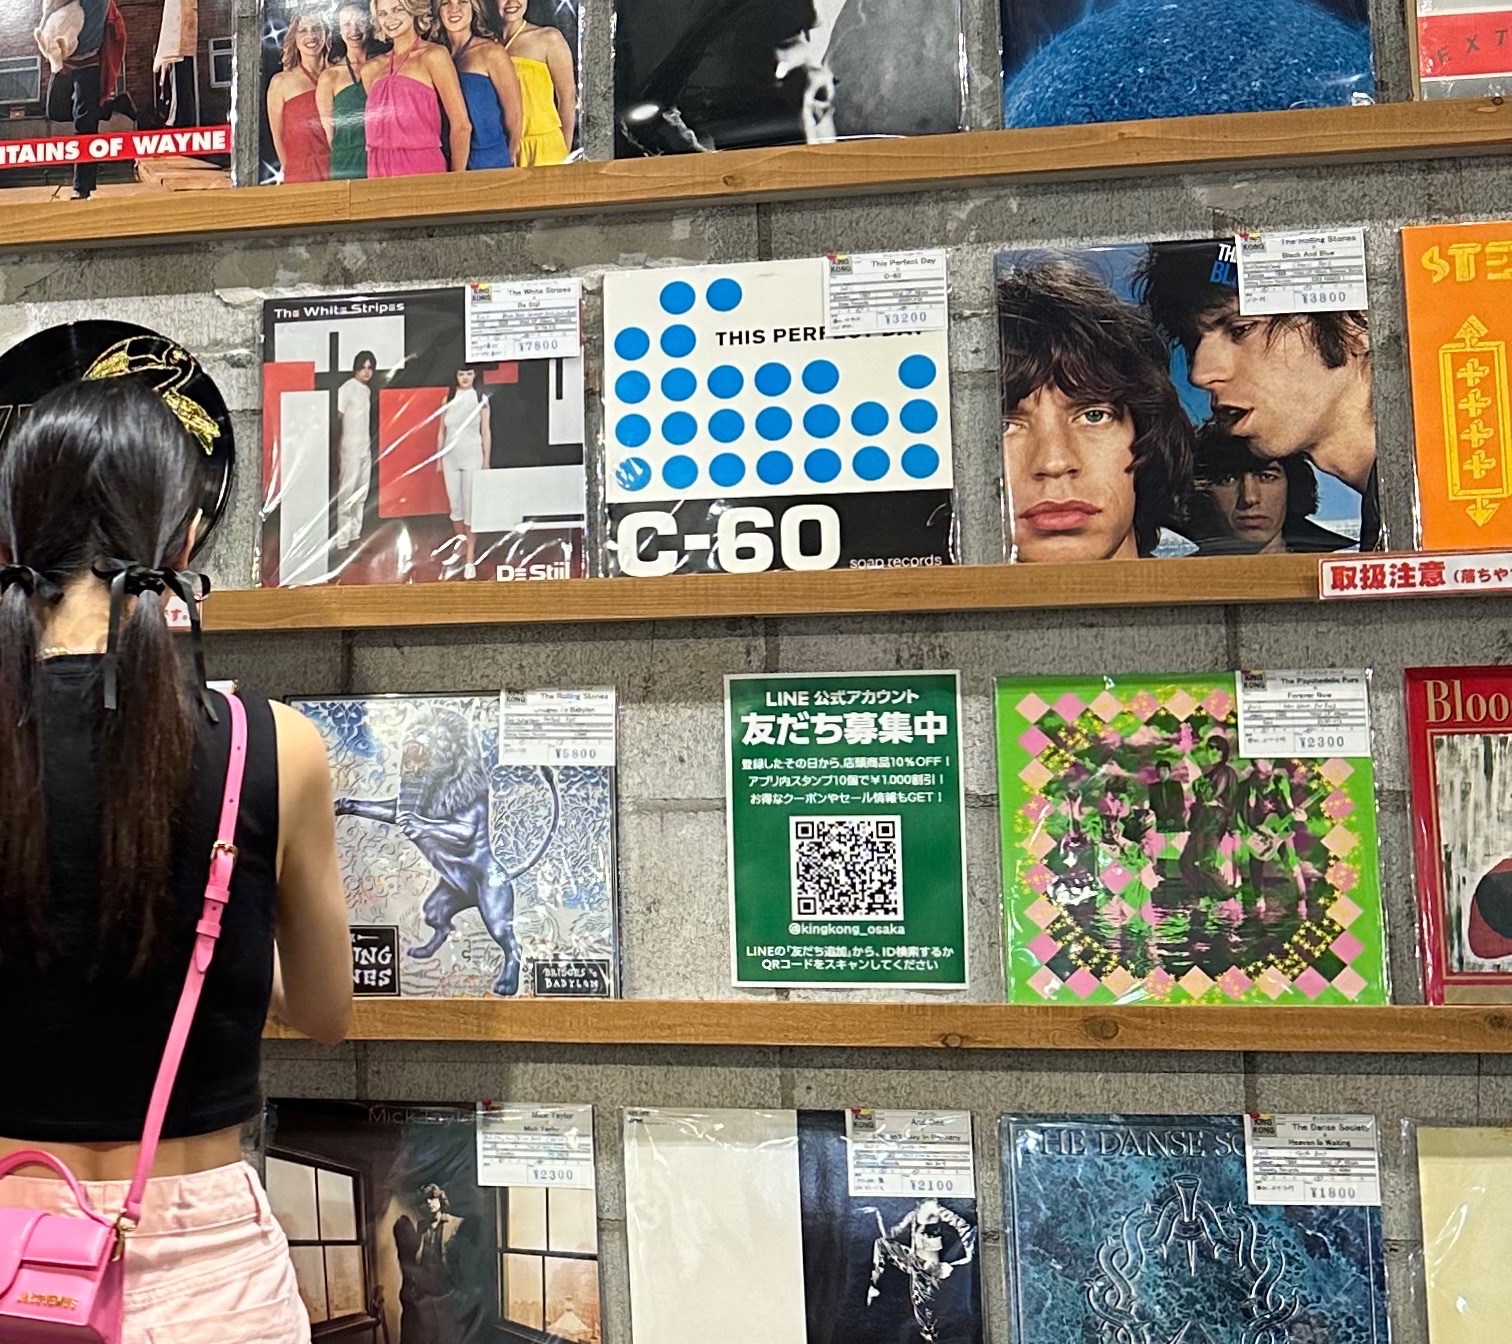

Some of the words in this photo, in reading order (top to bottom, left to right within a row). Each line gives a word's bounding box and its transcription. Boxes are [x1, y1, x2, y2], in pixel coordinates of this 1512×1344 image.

[88, 136, 126, 158] OF
[133, 130, 227, 155] WAYNE
[274, 308, 300, 319] The
[303, 305, 348, 318] White
[351, 301, 405, 315] Stripes
[715, 330, 765, 346] THIS
[617, 504, 841, 577] C-60
[849, 556, 886, 569] soap
[887, 553, 942, 568] records
[497, 564, 526, 582] De
[1330, 560, 1446, 592] 取扱注意
[765, 690, 809, 707] LINE
[813, 689, 920, 706] 公式アカウント
[740, 710, 948, 746] 友だち募集中
[1299, 735, 1344, 748] ¥2300
[788, 922, 906, 937] @kingkong_osaka
[1099, 1129, 1206, 1158] DANSE
[910, 1179, 954, 1191] ¥2100
[1310, 1187, 1355, 1199] ¥1800
